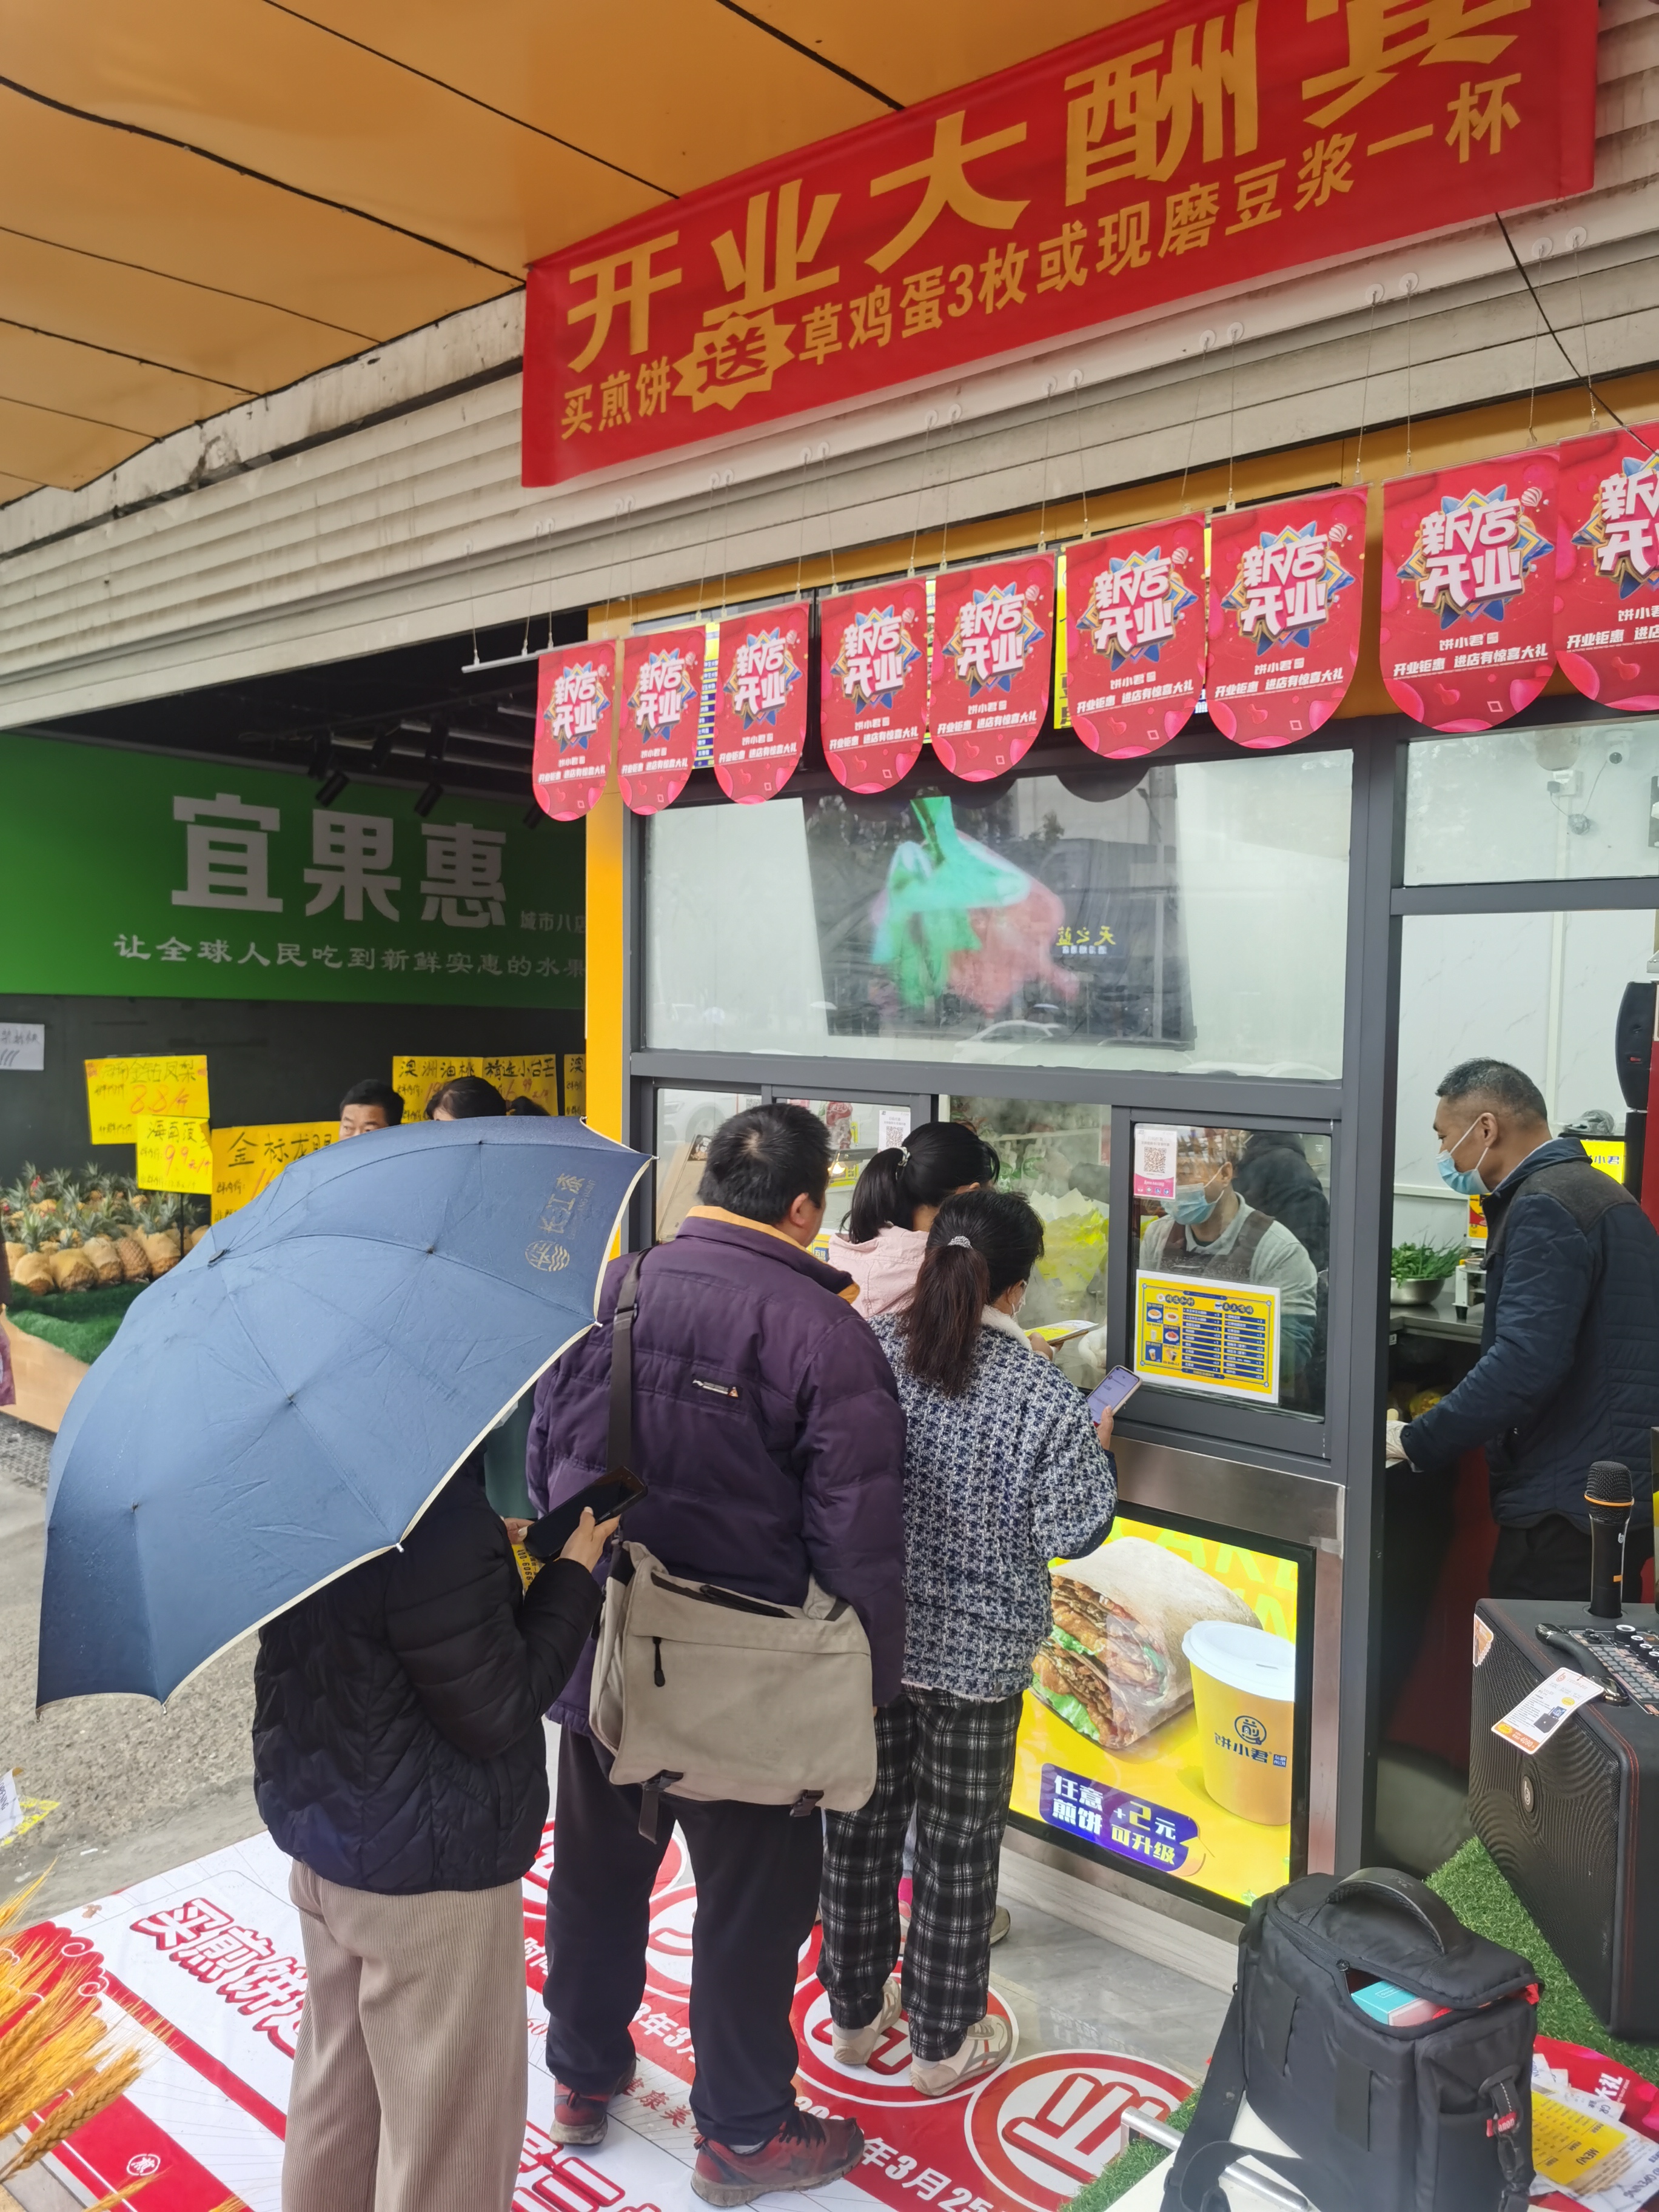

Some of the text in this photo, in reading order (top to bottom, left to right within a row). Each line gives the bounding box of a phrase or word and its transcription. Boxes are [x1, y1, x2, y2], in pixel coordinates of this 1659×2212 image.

[567, 0, 1531, 372] 开业大酬宾
[1601, 469, 1659, 520] 新
[1421, 498, 1520, 555] 新店
[1597, 519, 1659, 575] 开
[1243, 535, 1327, 587] 新店
[1419, 546, 1523, 607] 开业
[1095, 558, 1172, 608] 新店
[960, 595, 1024, 638] 新店
[1094, 599, 1173, 652] 开业
[1241, 578, 1327, 635] 开业
[737, 638, 786, 675] 新店
[844, 615, 902, 657] 新店
[957, 632, 1024, 679] 开业
[555, 671, 597, 704] 新店
[639, 659, 685, 692] 新店
[734, 674, 786, 714] 开业
[843, 651, 903, 698] 开业
[554, 703, 597, 739] 开业
[636, 690, 681, 729] 开业
[172, 793, 506, 928] 宜果惠
[114, 934, 586, 978] 让全球人民吃到新鲜实惠的水果
[1589, 1155, 1620, 1165] 小君
[1214, 1732, 1268, 1763] 饼小君
[1054, 1775, 1104, 1811] 任意
[1052, 1798, 1104, 1837] 煎饼
[1114, 1799, 1177, 1842] +2元
[1111, 1825, 1177, 1868] 可升级
[130, 1897, 308, 2059] 买煎饼
